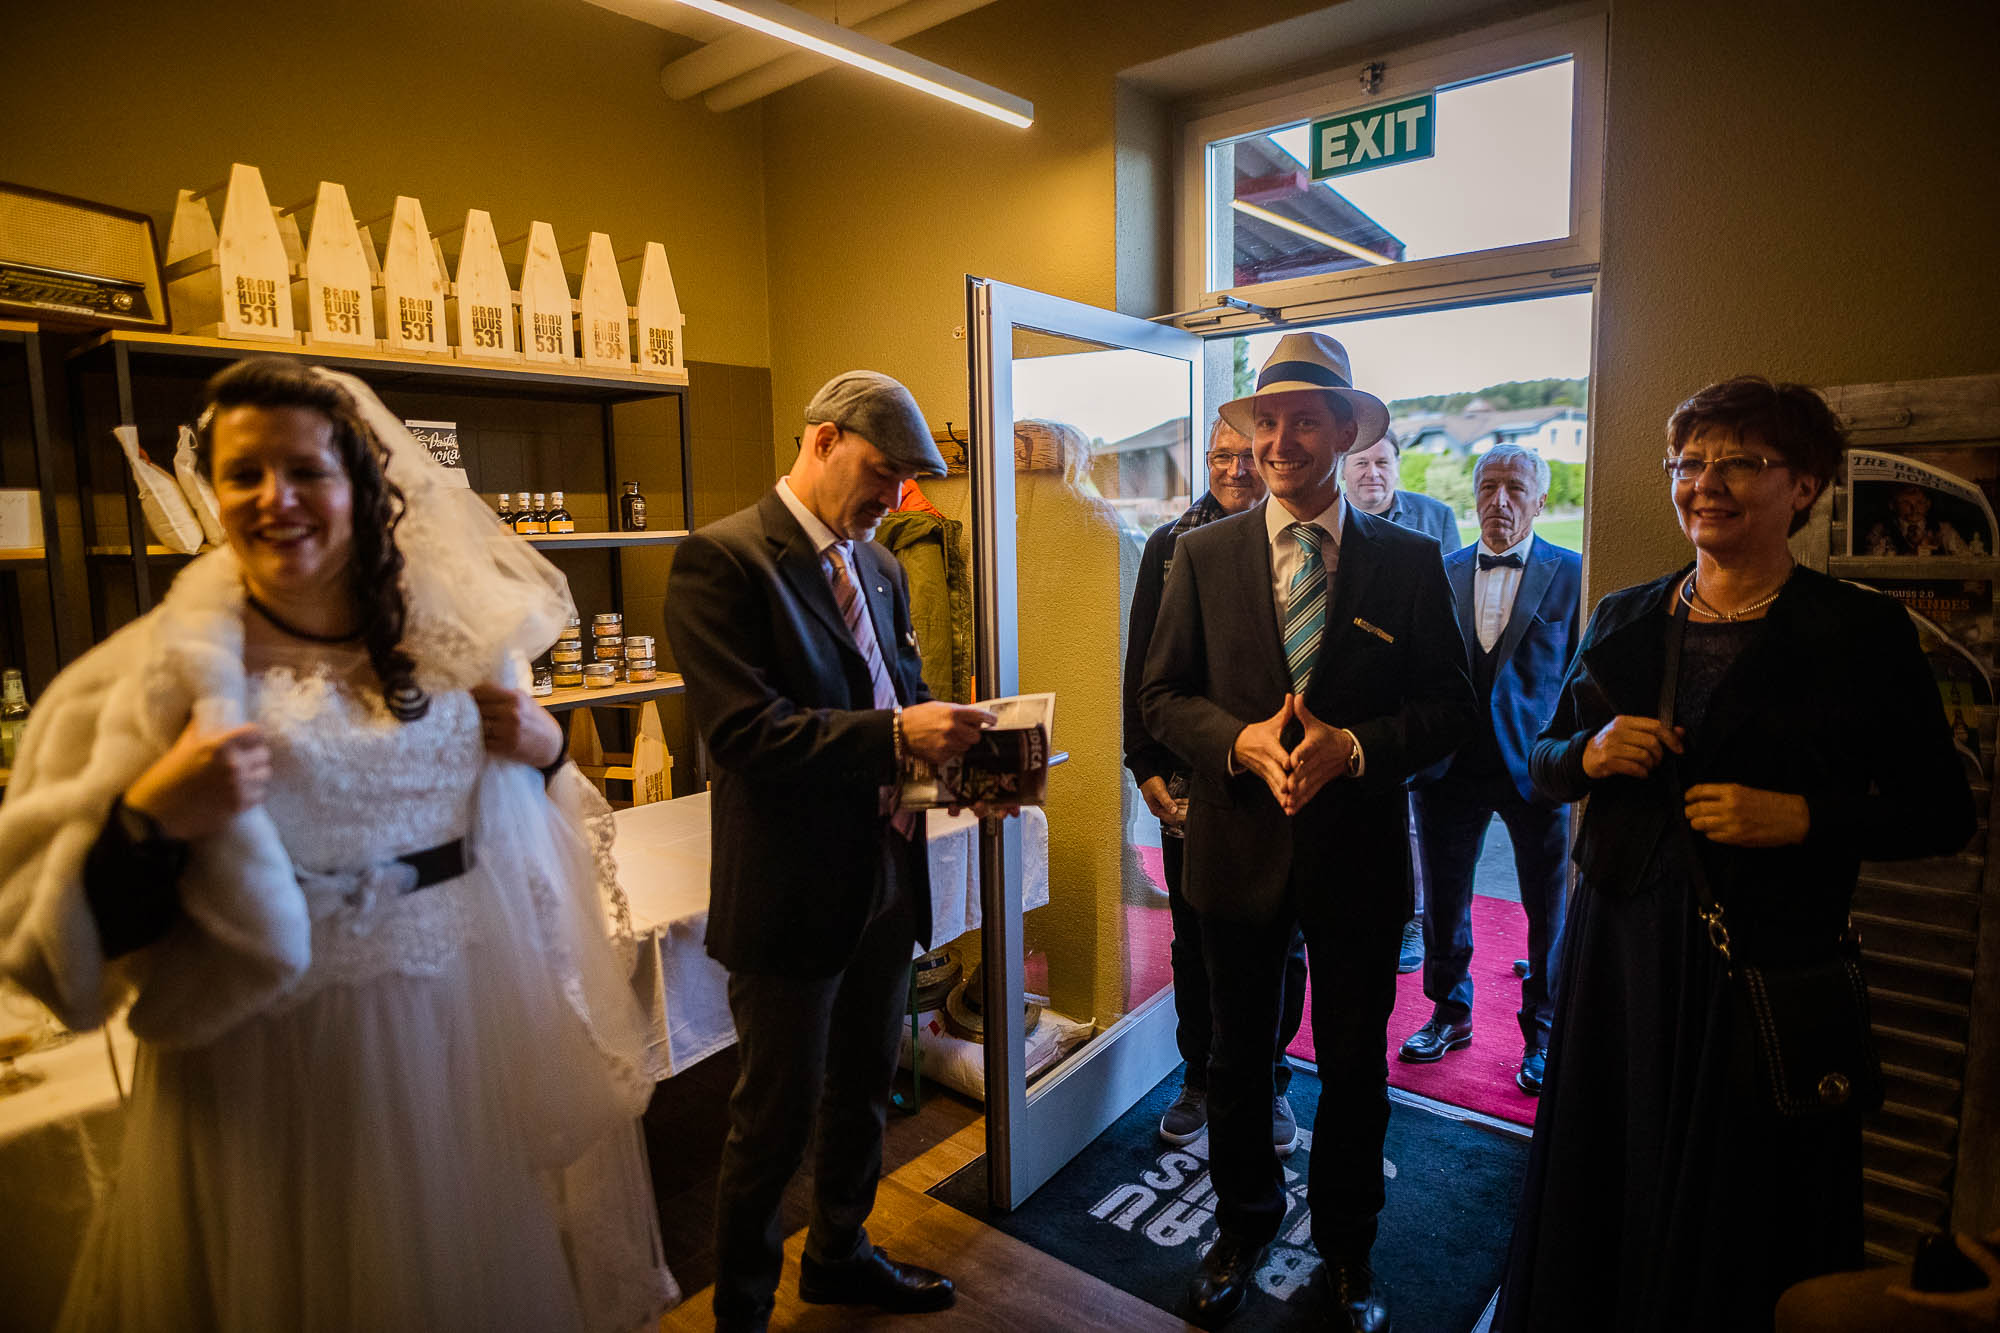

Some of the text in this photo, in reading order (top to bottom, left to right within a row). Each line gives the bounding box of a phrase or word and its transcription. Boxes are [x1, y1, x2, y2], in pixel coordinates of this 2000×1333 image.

[1321, 105, 1426, 170] EXIT
[236, 276, 275, 294] BRAU
[237, 290, 276, 306] HUUS
[323, 286, 360, 302] BRAU
[324, 299, 360, 315] HUUS
[399, 297, 432, 312] BRAU
[472, 305, 501, 319] BRAU
[239, 304, 278, 328] 531
[326, 313, 361, 335] 531
[400, 309, 432, 324] HUUS
[472, 317, 502, 330] HUUS
[533, 313, 562, 325] BRAU
[401, 321, 434, 343] 531
[473, 328, 503, 349] 531
[534, 324, 562, 337] HUUS
[649, 327, 673, 340] BRAU
[535, 335, 563, 354] 531
[649, 338, 674, 350] HUUS
[651, 349, 674, 367] 531
[1853, 456, 1888, 468] THE
